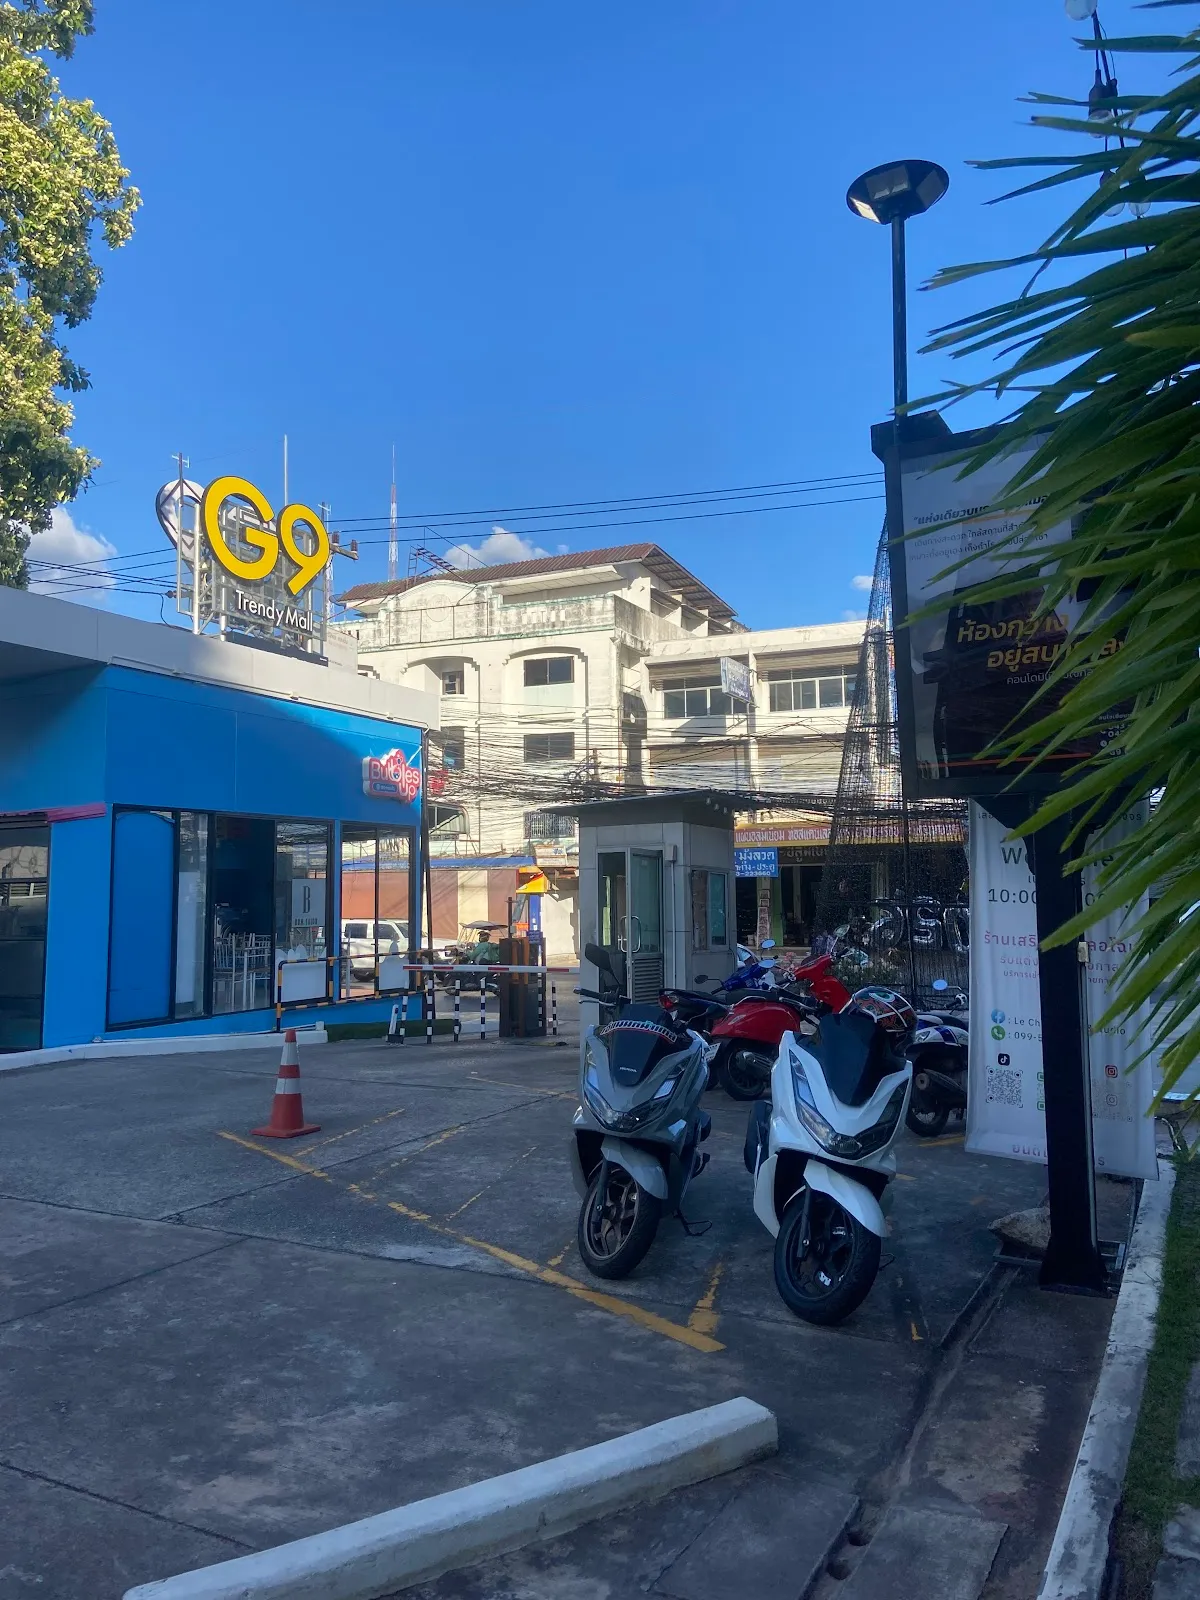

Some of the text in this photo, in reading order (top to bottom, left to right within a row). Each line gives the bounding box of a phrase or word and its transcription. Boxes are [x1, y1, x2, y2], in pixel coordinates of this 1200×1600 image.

[201, 475, 330, 596] G9
[236, 590, 313, 632] Trendy Mall
[399, 782, 416, 801] Up
[302, 885, 311, 914] B
[1014, 1017, 1025, 1026] Le
